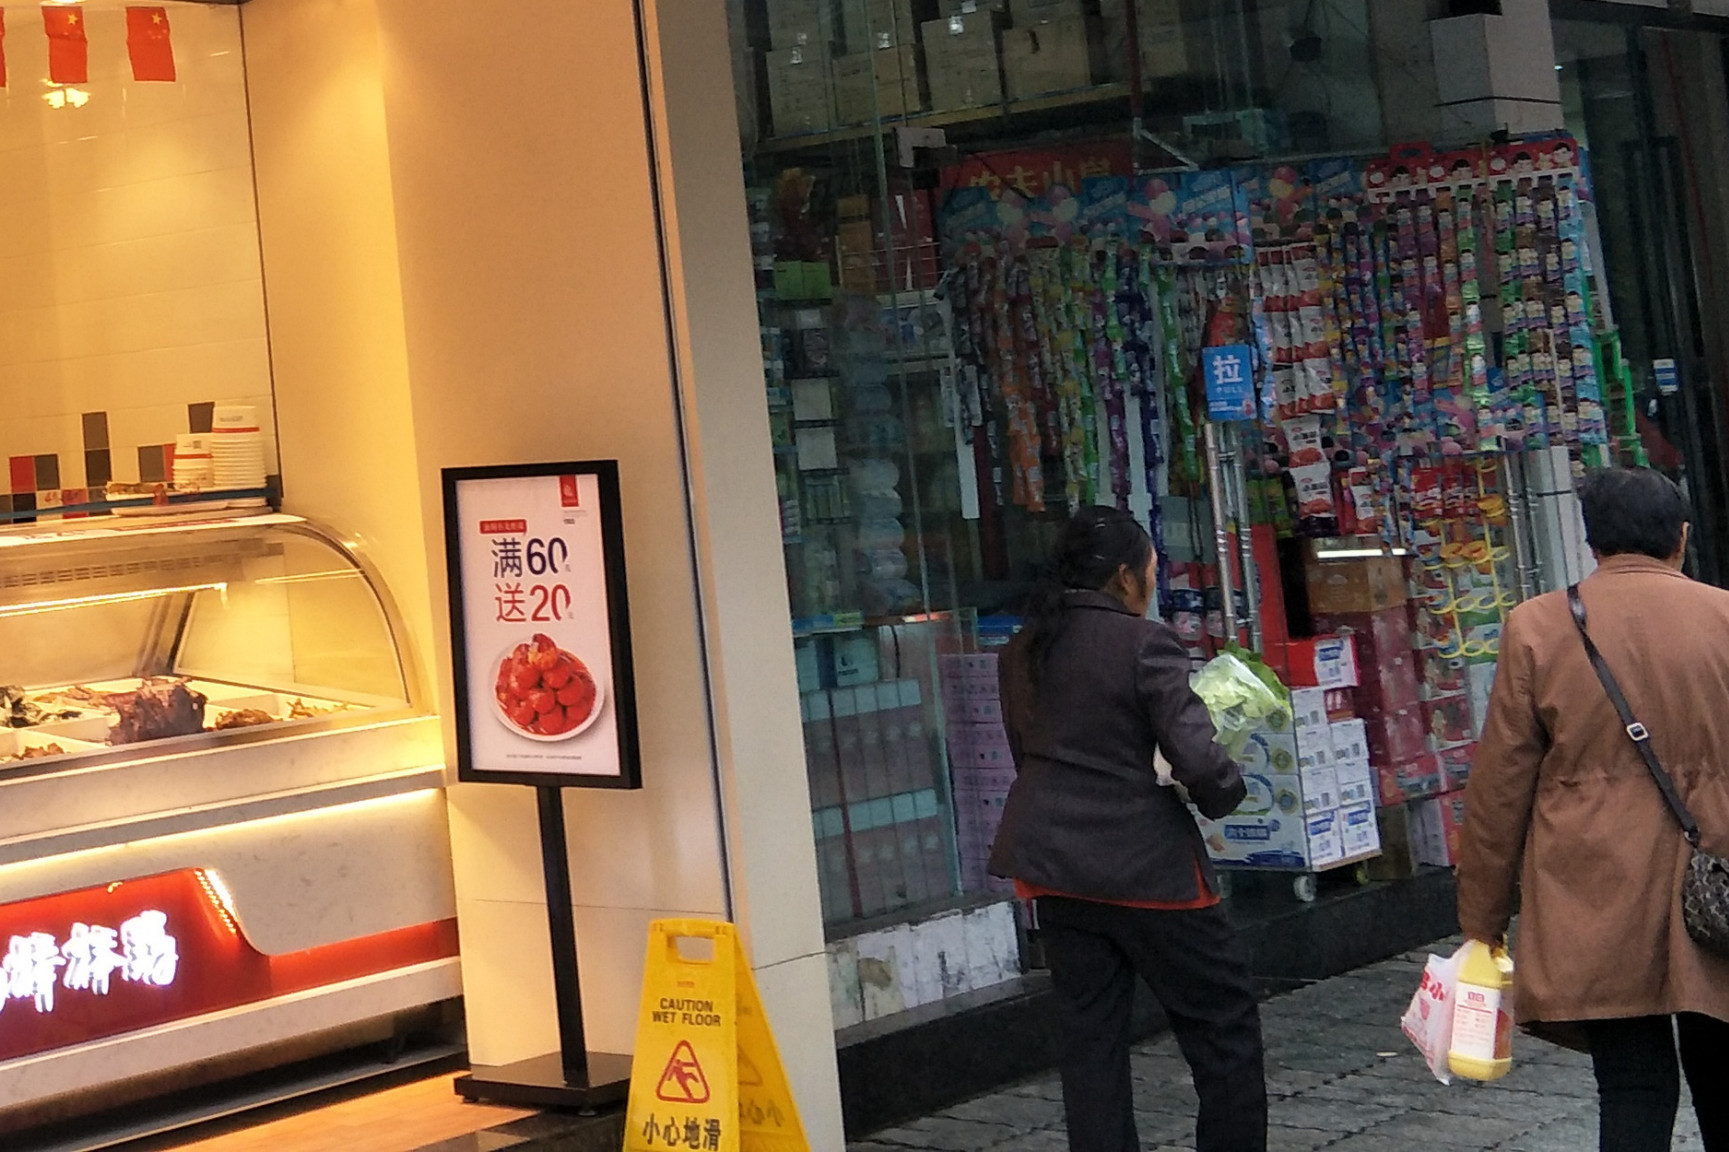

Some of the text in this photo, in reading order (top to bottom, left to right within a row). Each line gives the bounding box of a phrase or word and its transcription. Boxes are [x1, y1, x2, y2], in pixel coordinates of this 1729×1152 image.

[1212, 355, 1243, 384] 拉
[659, 997, 714, 1013] CAUTION
[652, 1010, 721, 1027] WET FLOOR
[642, 1112, 722, 1152] 小心地滑
